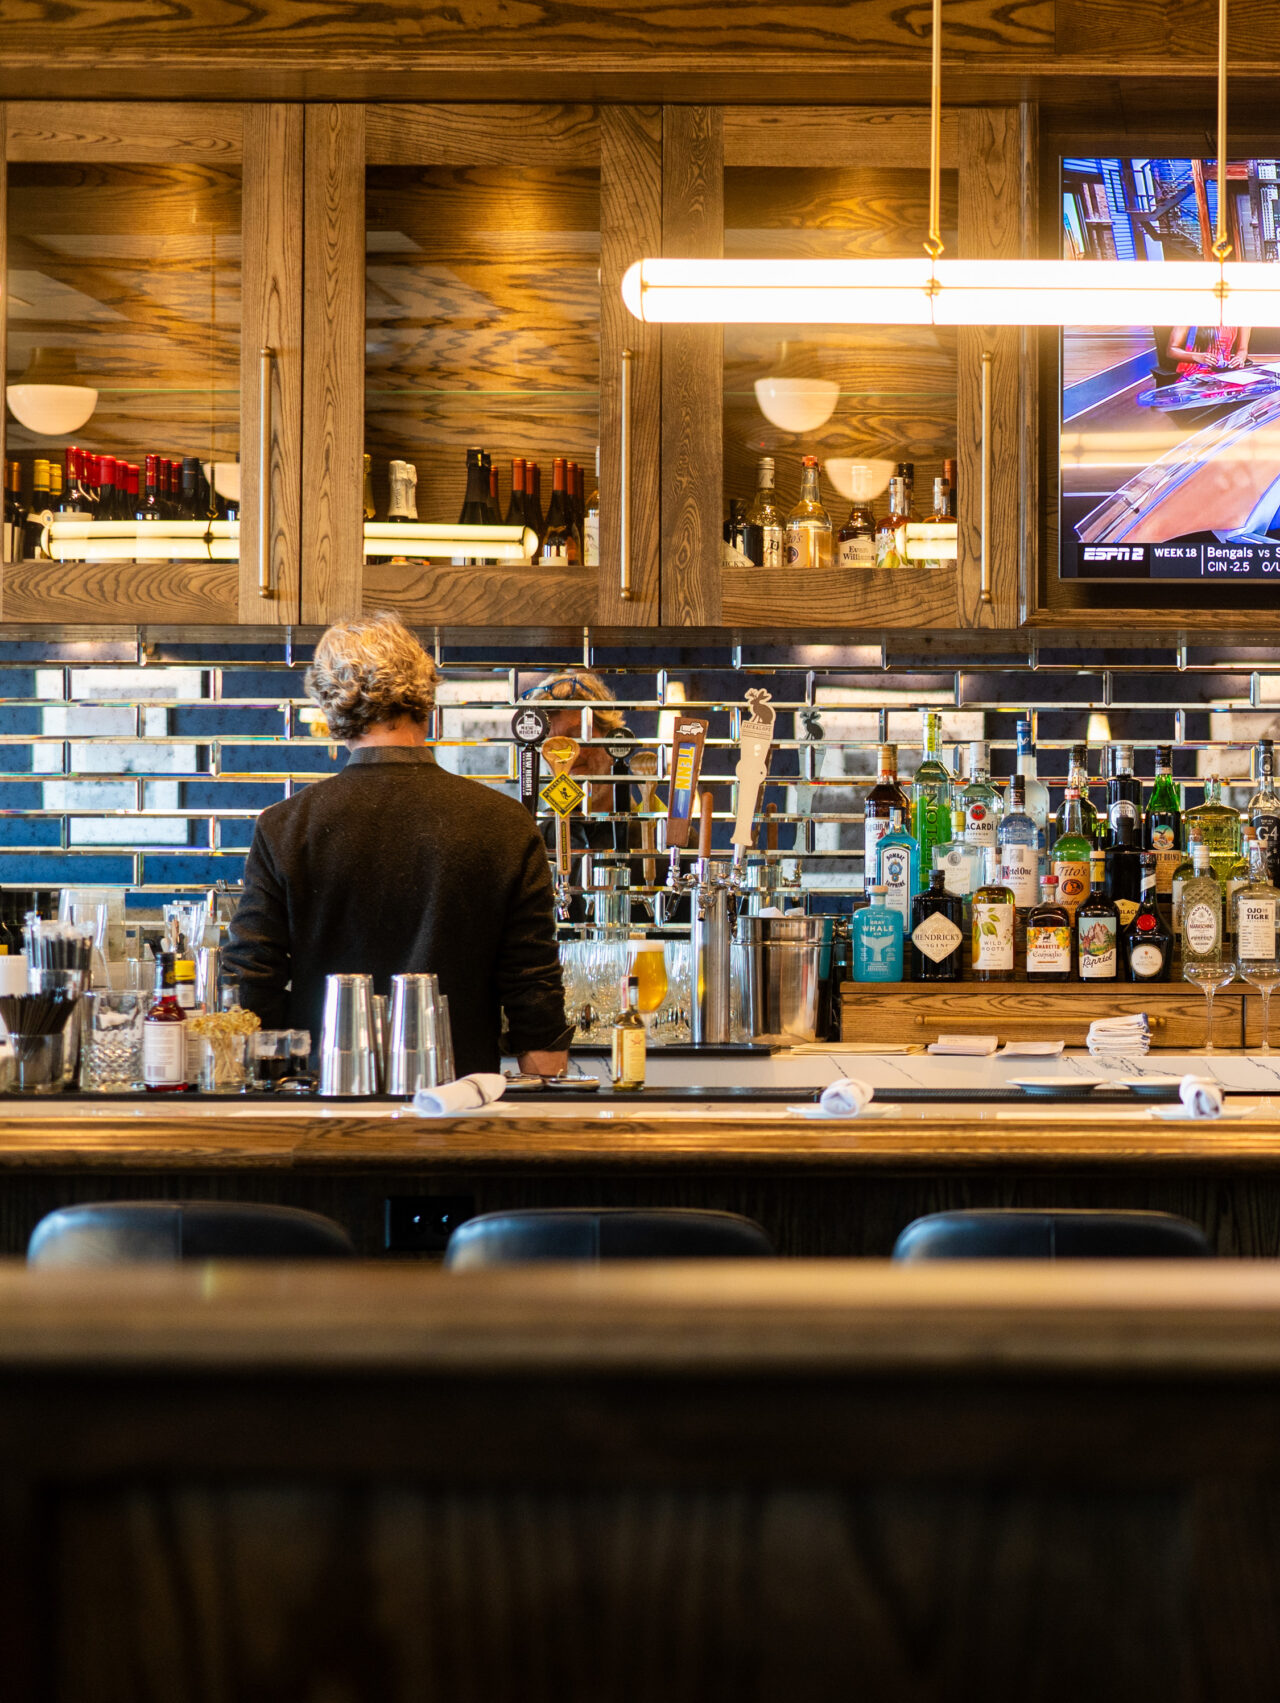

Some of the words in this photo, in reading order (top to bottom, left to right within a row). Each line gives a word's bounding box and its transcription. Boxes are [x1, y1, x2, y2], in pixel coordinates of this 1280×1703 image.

[1154, 548, 1183, 557] WEEK
[1185, 548, 1197, 557] 18
[1207, 547, 1253, 559] Bengals
[1207, 562, 1227, 571] CIN
[1229, 562, 1250, 571] -2.5
[525, 752, 533, 769] NEW
[675, 746, 695, 790] TENN
[525, 769, 533, 796] HEIGHTS
[926, 793, 938, 869] EBLON
[966, 821, 994, 830] ACARDÍ
[1256, 826, 1278, 840] G4
[886, 853, 905, 861] BOMBAY
[1002, 866, 1020, 879] Ketel
[1059, 865, 1087, 876] Tito's
[885, 880, 906, 888] SAPPHIRE
